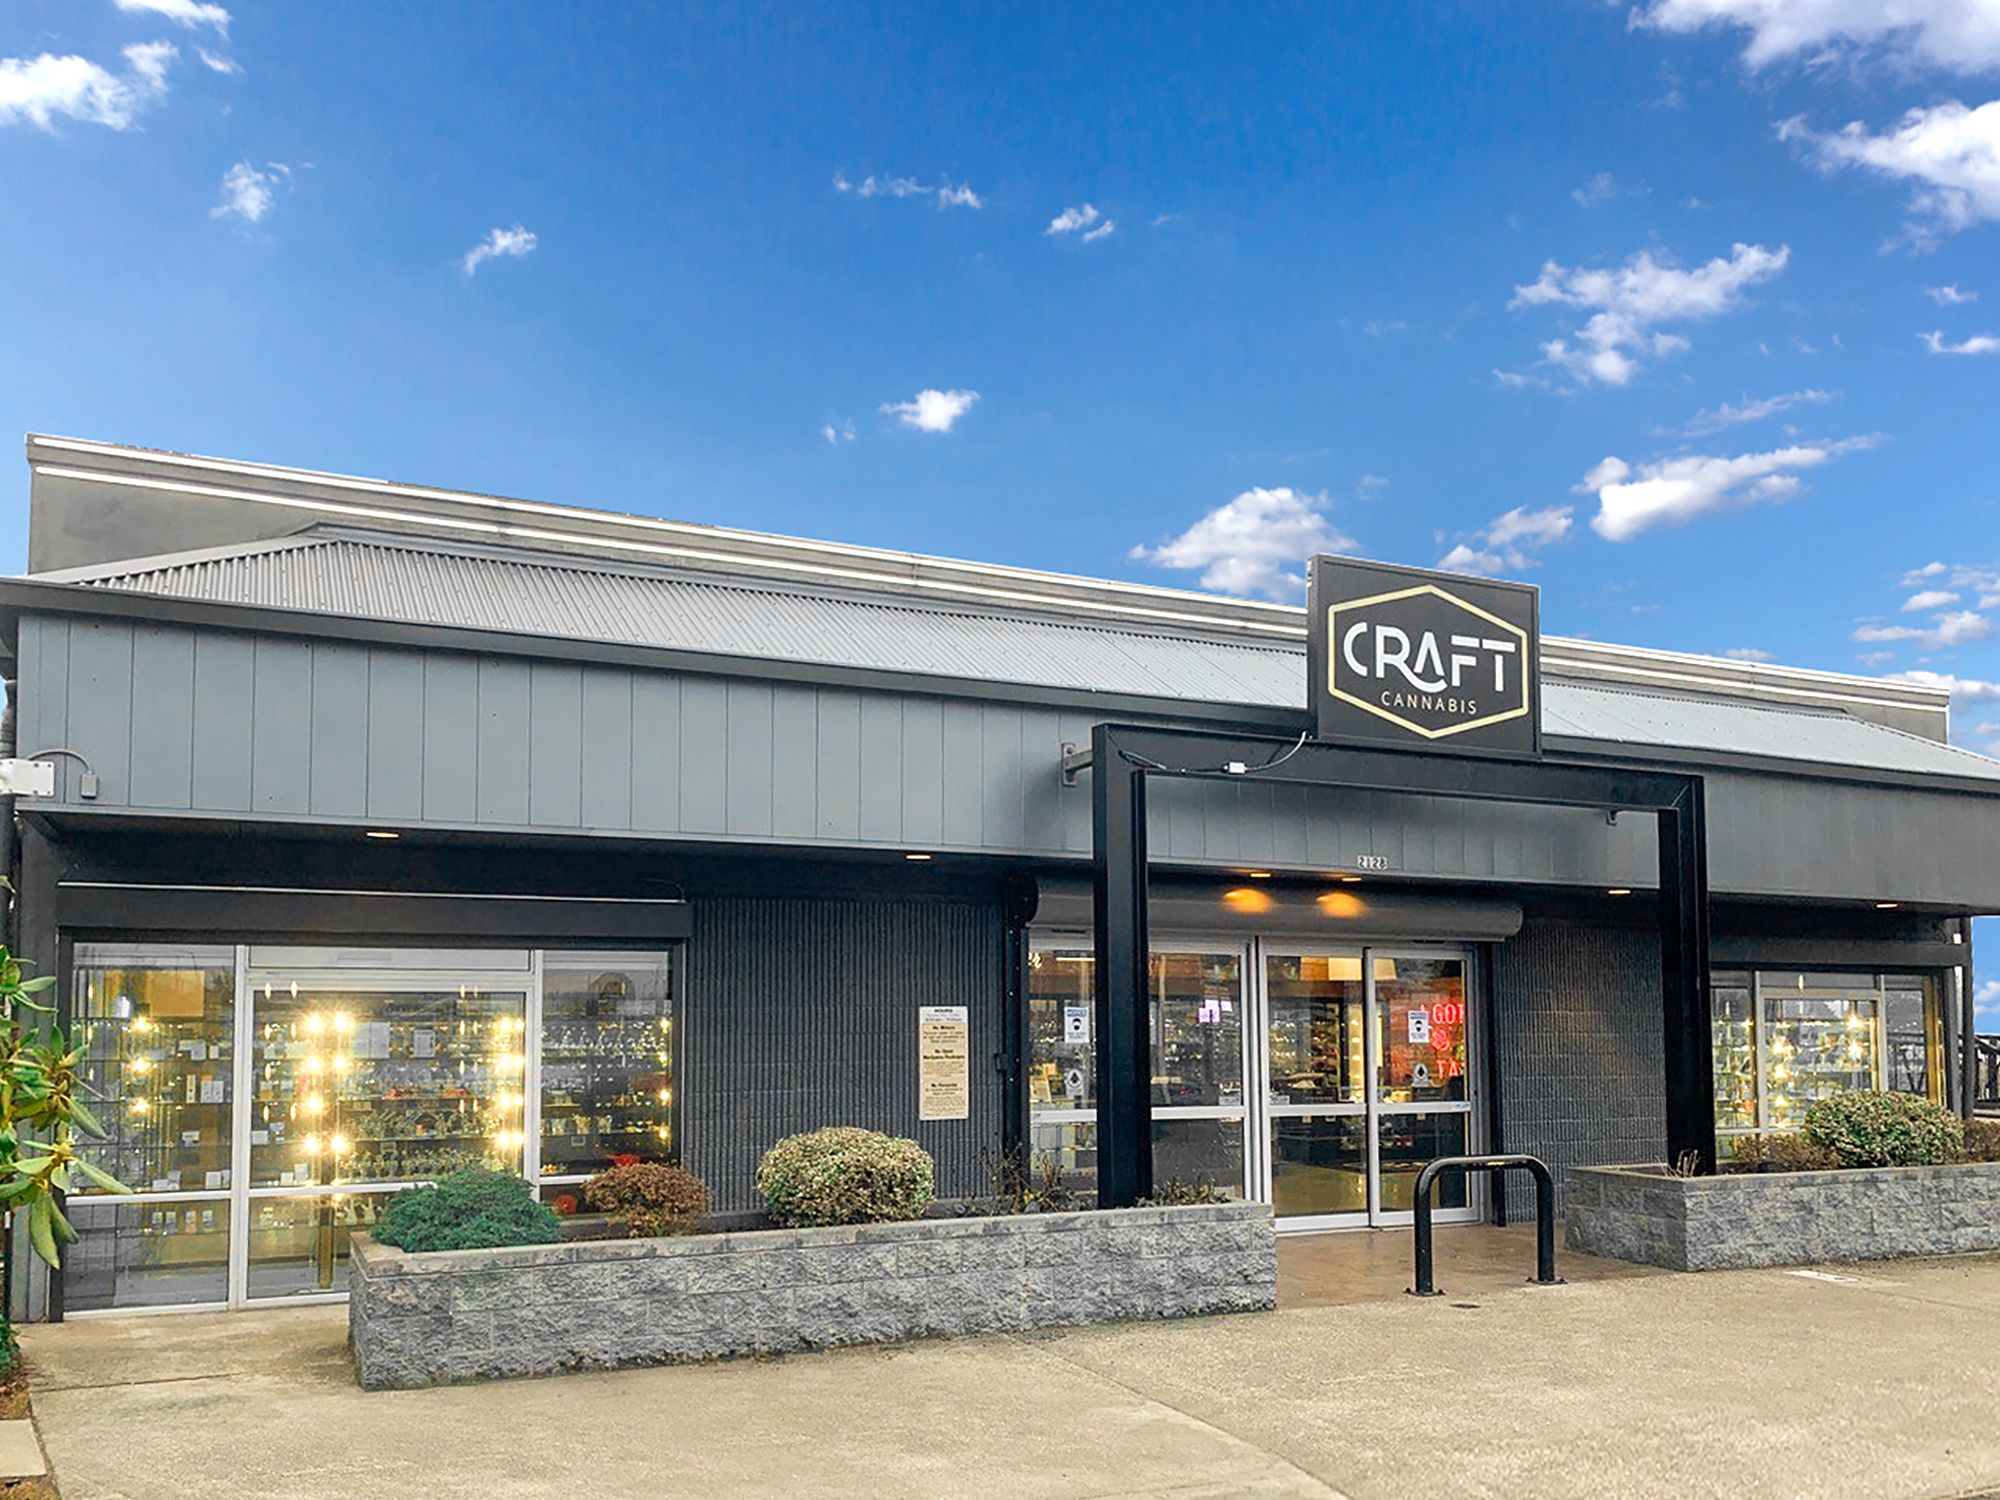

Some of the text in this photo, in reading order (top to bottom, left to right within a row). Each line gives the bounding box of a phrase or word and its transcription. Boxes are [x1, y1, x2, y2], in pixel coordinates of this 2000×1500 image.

[1343, 621, 1516, 693] CRAFT
[1381, 690, 1477, 716] CANNABIS
[1359, 856, 1386, 870] 2128
